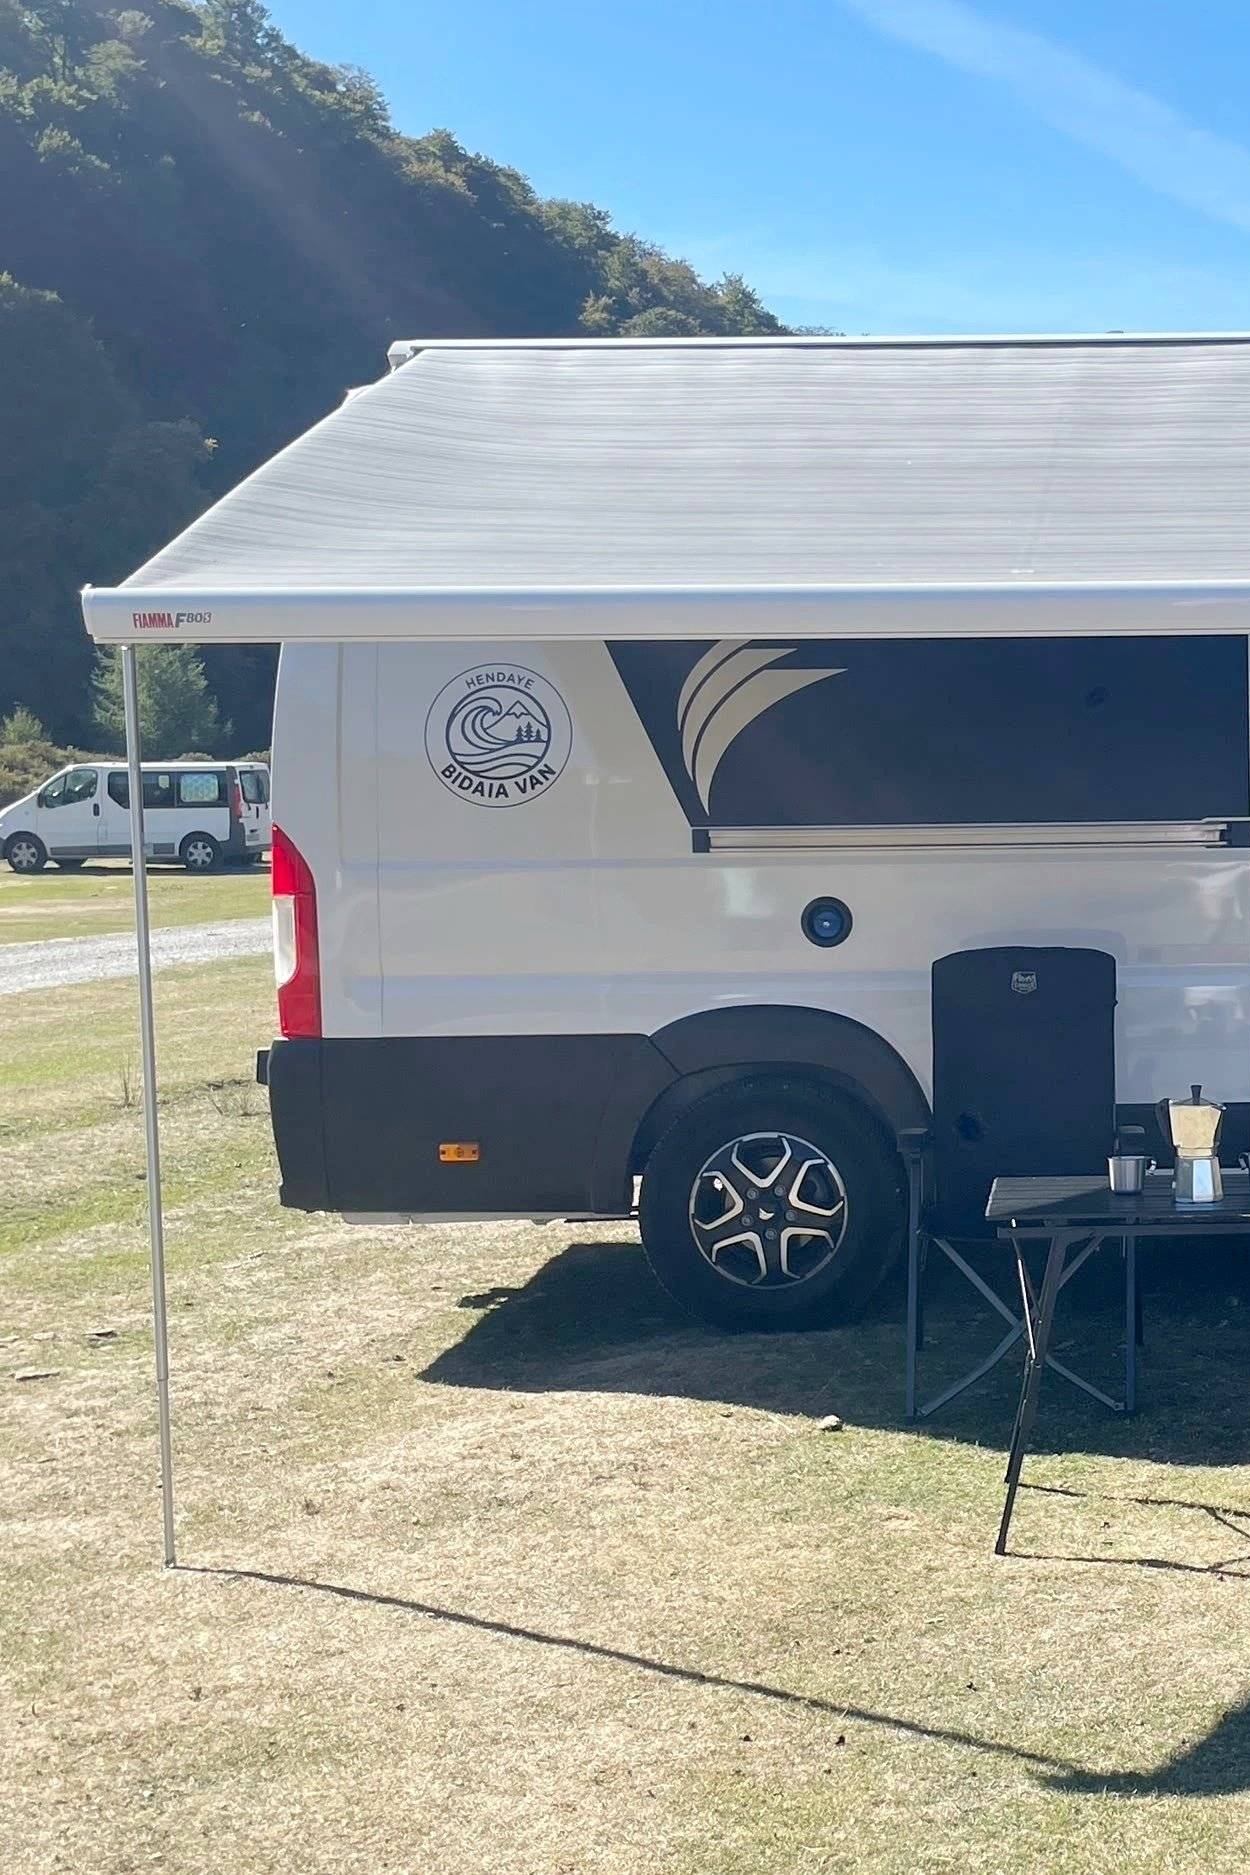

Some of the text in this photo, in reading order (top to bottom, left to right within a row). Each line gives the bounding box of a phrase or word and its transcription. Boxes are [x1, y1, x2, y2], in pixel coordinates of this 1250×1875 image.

[133, 612, 174, 628] FIAMMA
[465, 672, 535, 690] HENDAYE
[440, 763, 556, 798] BIDAIA VAN
